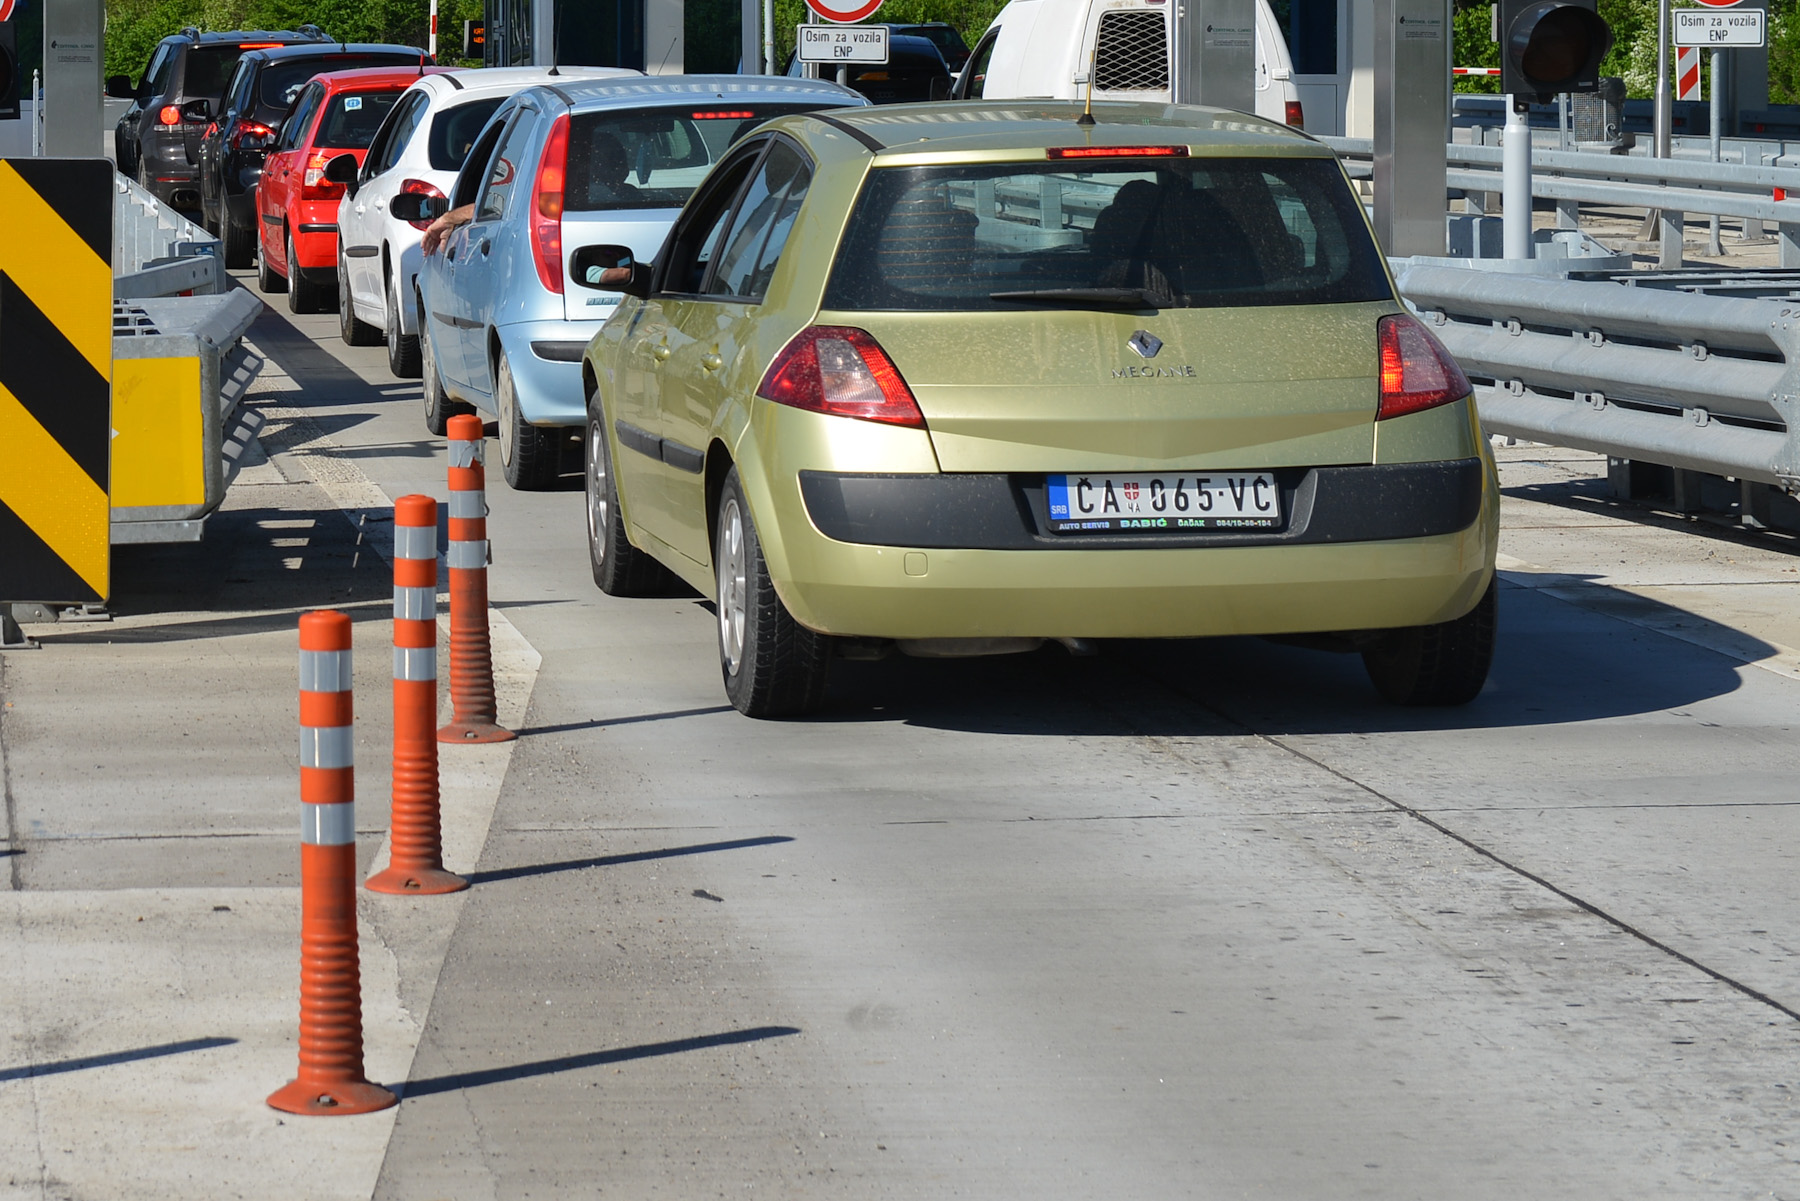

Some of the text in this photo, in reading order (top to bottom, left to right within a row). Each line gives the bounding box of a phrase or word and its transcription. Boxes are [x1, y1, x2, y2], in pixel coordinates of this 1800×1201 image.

[1680, 14, 1757, 27] Osim za vozila
[806, 30, 881, 43] Osim za vozila
[1709, 29, 1729, 42] ENP
[833, 46, 853, 57] ENP
[1111, 365, 1197, 379] MEGANE
[1076, 477, 1121, 514] ČA
[1051, 505, 1068, 515] SRB
[1081, 521, 1110, 529] SERVIS
[1120, 517, 1168, 528] BABIĆ
